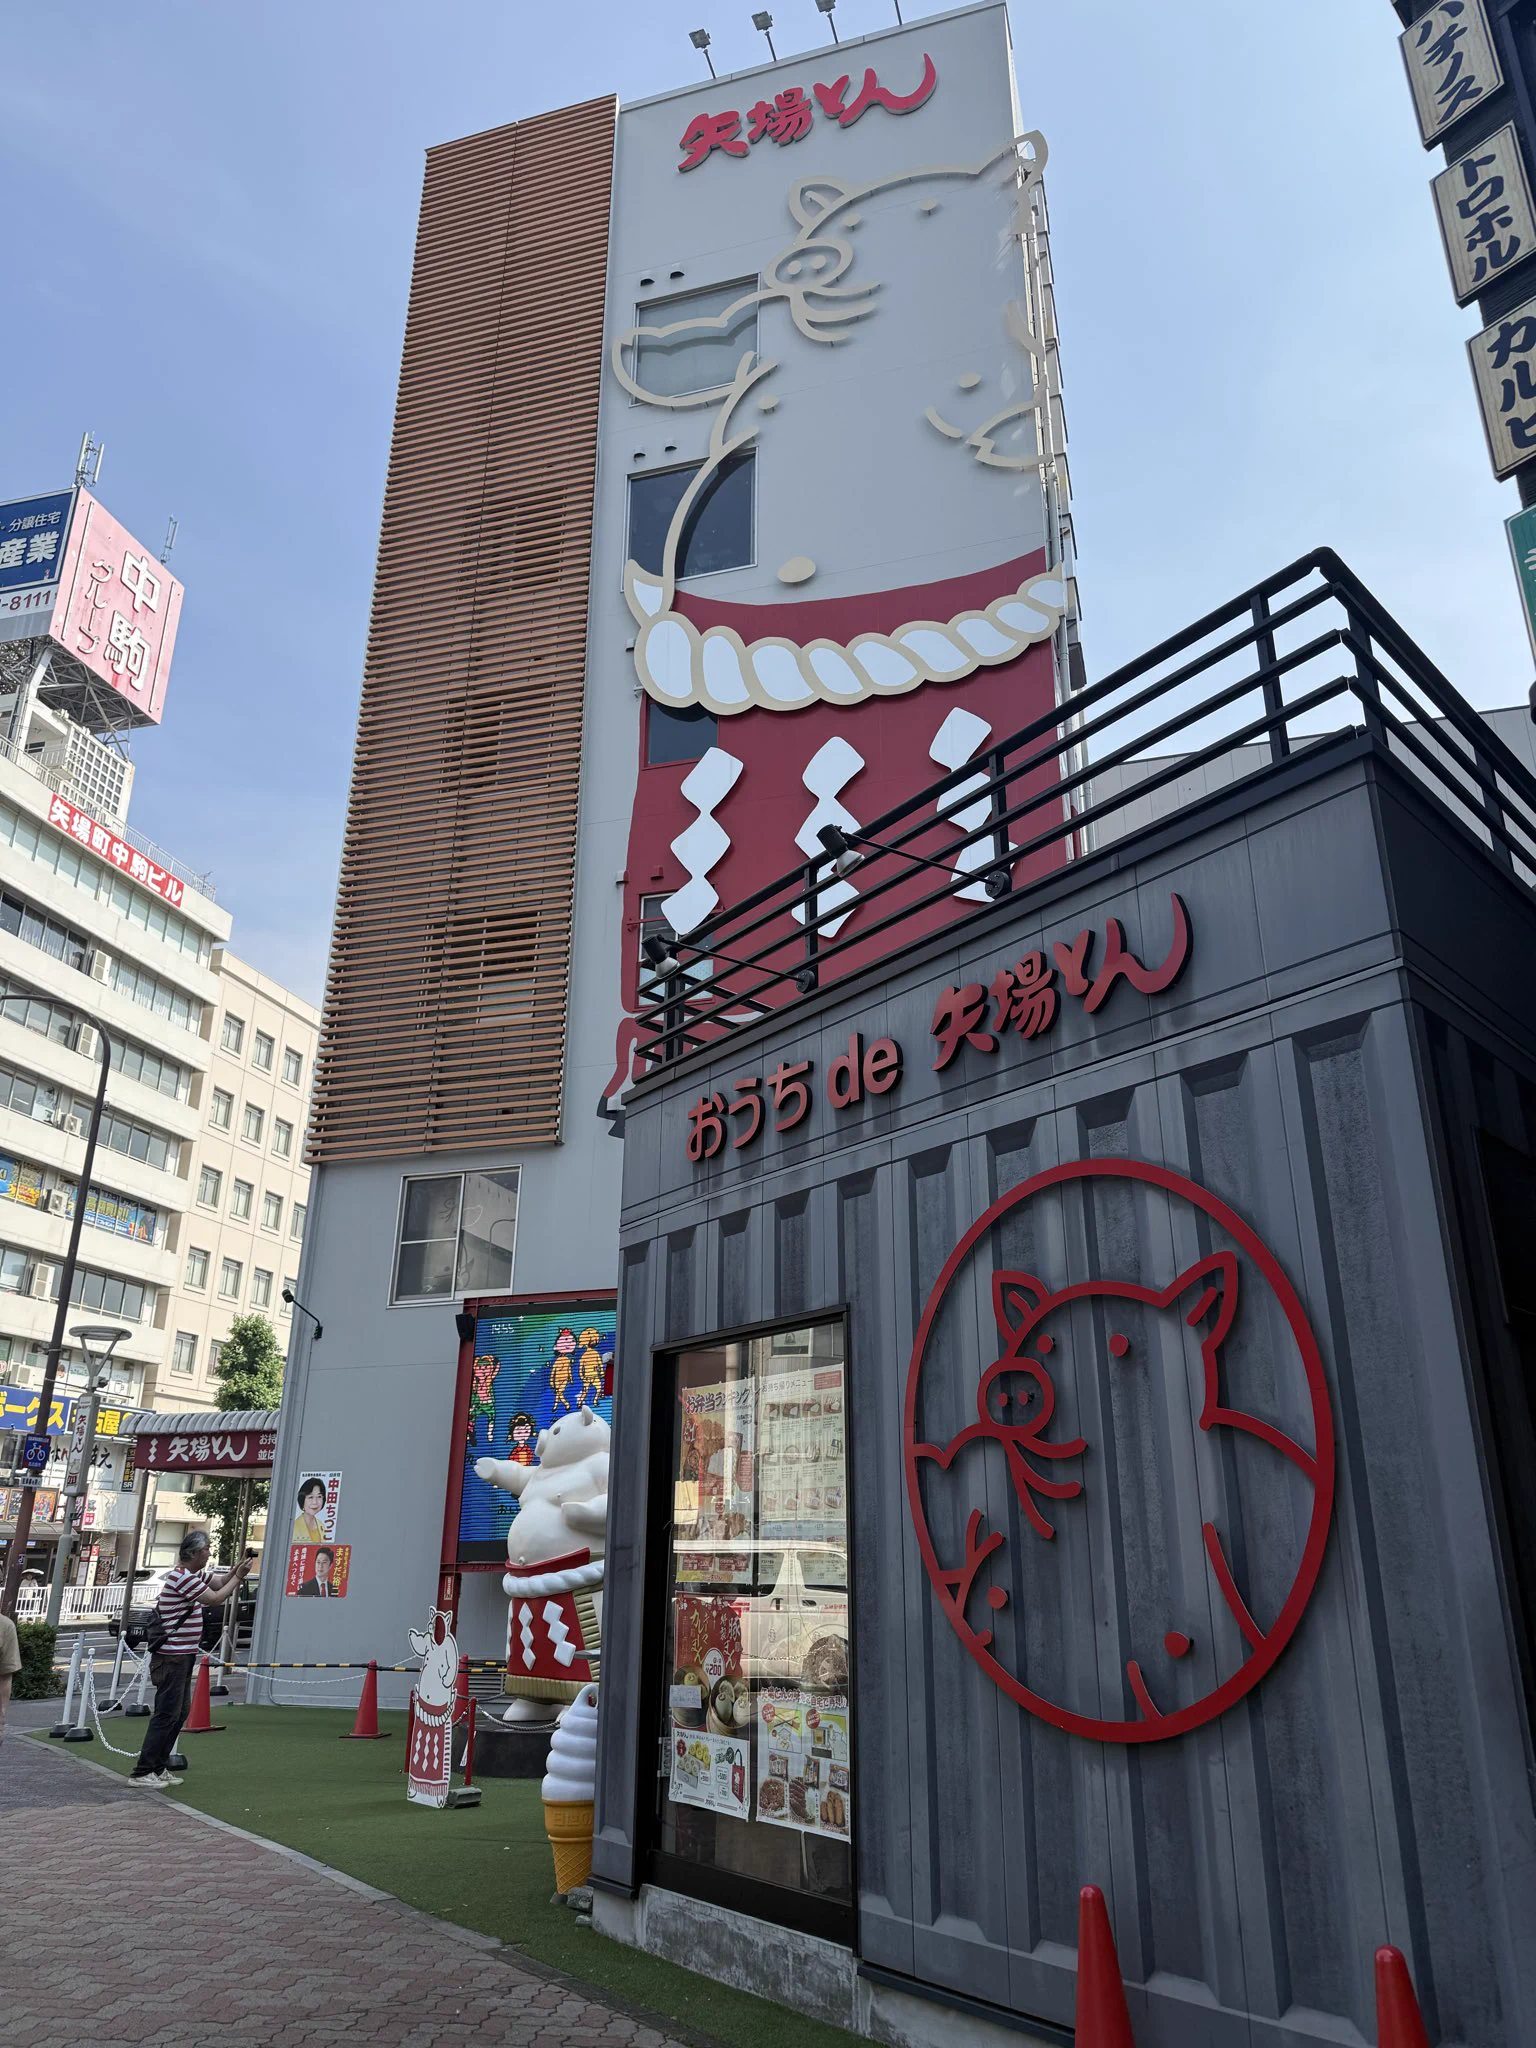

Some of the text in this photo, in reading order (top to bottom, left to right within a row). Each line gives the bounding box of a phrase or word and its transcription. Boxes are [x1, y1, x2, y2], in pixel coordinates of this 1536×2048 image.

[678, 53, 937, 173] 矢場とん
[1415, 1, 1483, 126] ハチノス
[1457, 154, 1521, 283] トロホル
[77, 559, 114, 655] グループ
[103, 550, 161, 692] 中駒
[50, 798, 183, 902] 矢場町中駒ビル
[685, 893, 1195, 1163] おうち de 矢場とん
[166, 1435, 248, 1462] 矢場とん
[323, 1478, 339, 1541] 中田ちづこ
